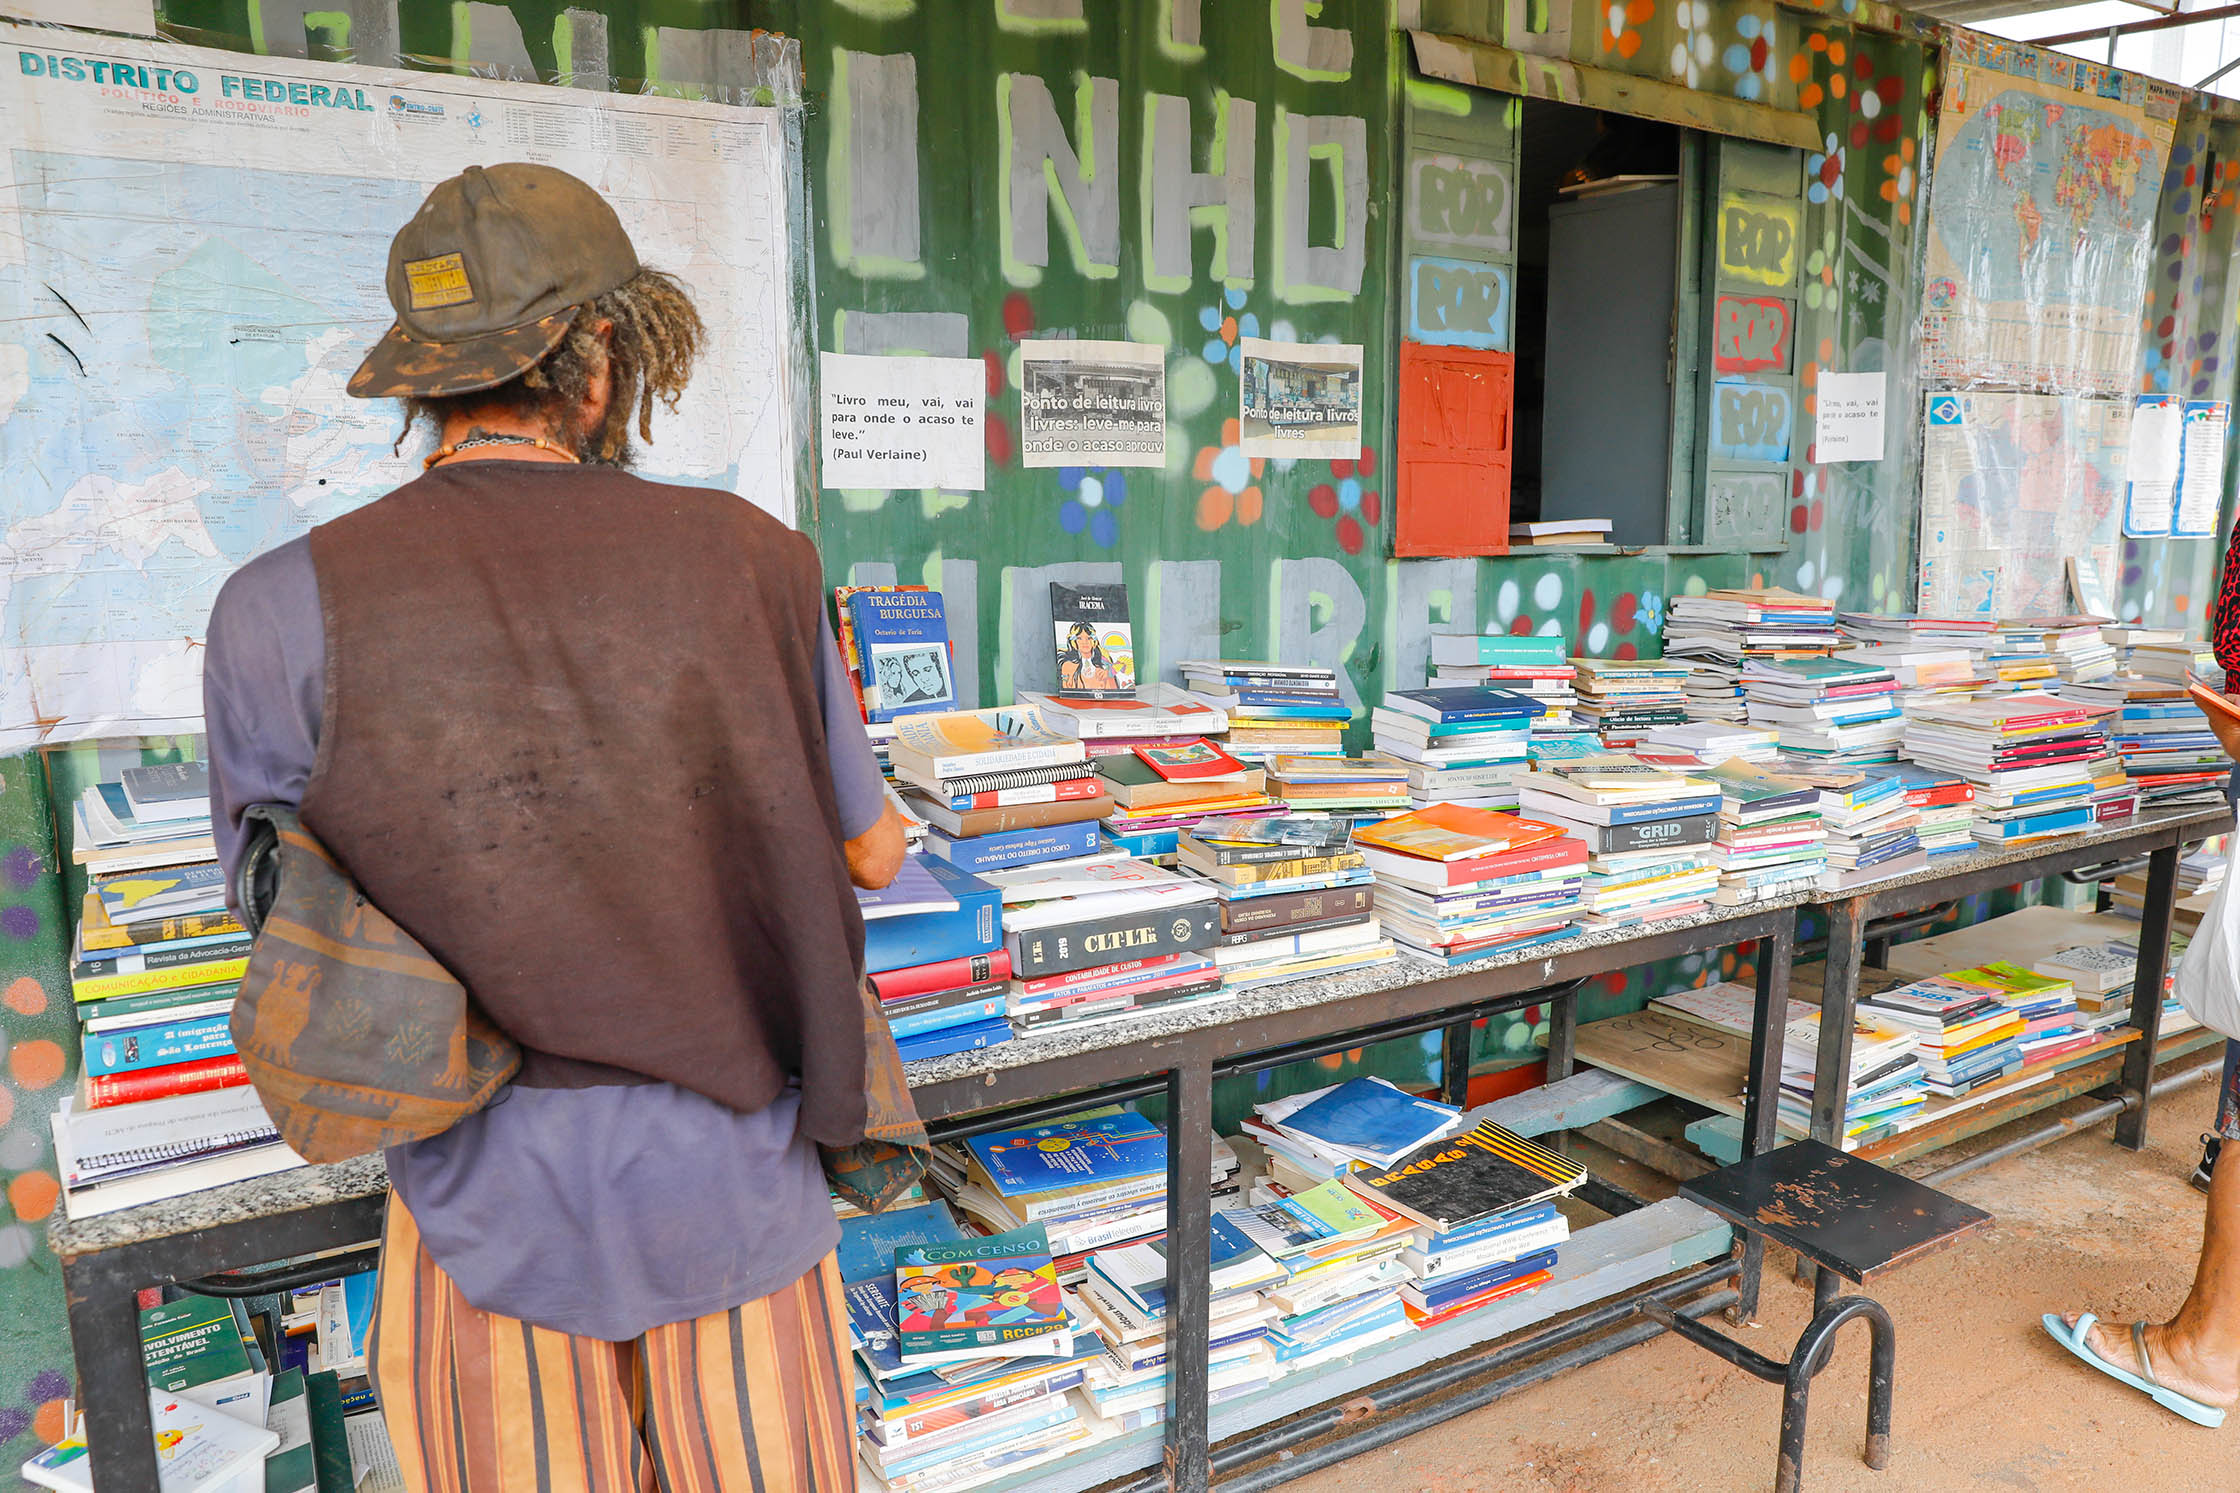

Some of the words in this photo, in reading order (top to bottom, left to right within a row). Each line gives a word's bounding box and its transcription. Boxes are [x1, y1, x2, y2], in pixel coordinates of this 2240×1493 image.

[19, 51, 200, 94] DISTRITO
[221, 75, 376, 112] FEDERAL
[877, 397, 910, 409] meu,
[921, 396, 945, 409] vai,
[955, 398, 974, 409] vai
[1072, 394, 1092, 410] de
[1095, 394, 1136, 411] leitura
[1137, 396, 1164, 411] livro
[831, 413, 857, 424] para
[863, 413, 896, 424] onde
[903, 415, 911, 424] o
[918, 415, 956, 425] acaso
[962, 415, 975, 425] te
[1242, 405, 1268, 419] Ponto
[1269, 407, 1280, 420] de
[1283, 407, 1324, 421] leitura
[1029, 415, 1079, 432] livres:
[1083, 415, 1135, 432] leve-me
[1136, 420, 1161, 434] para
[1274, 425, 1305, 440] livres
[1024, 436, 1064, 452] onde
[1067, 440, 1079, 452] o
[1083, 439, 1124, 452] acaso
[1125, 440, 1164, 454] aprouv
[832, 447, 863, 461] (Paul
[866, 449, 928, 462] Verlaine)
[867, 592, 928, 607] TRAGÉDIA
[1078, 600, 1105, 610] IRACEMA
[879, 607, 943, 620] BURGUESA
[1639, 823, 1682, 839] GRID
[975, 853, 1006, 864] TRABALHO
[179, 951, 189, 961] da
[189, 943, 253, 960] Advocacia-Geral
[1065, 966, 1110, 983] CONTABILIDADE
[1111, 964, 1119, 974] DE
[1119, 960, 1142, 972] CUSTOS
[84, 975, 168, 994] COMUNICAÇÃO
[181, 966, 239, 981] CIDADANIA
[177, 1023, 229, 1038] imigração
[202, 1033, 226, 1042] para
[1367, 1148, 1468, 1188] BRASAS
[927, 1249, 973, 1260] COM
[977, 1240, 1041, 1256] CENSO
[910, 1420, 924, 1433] TST
